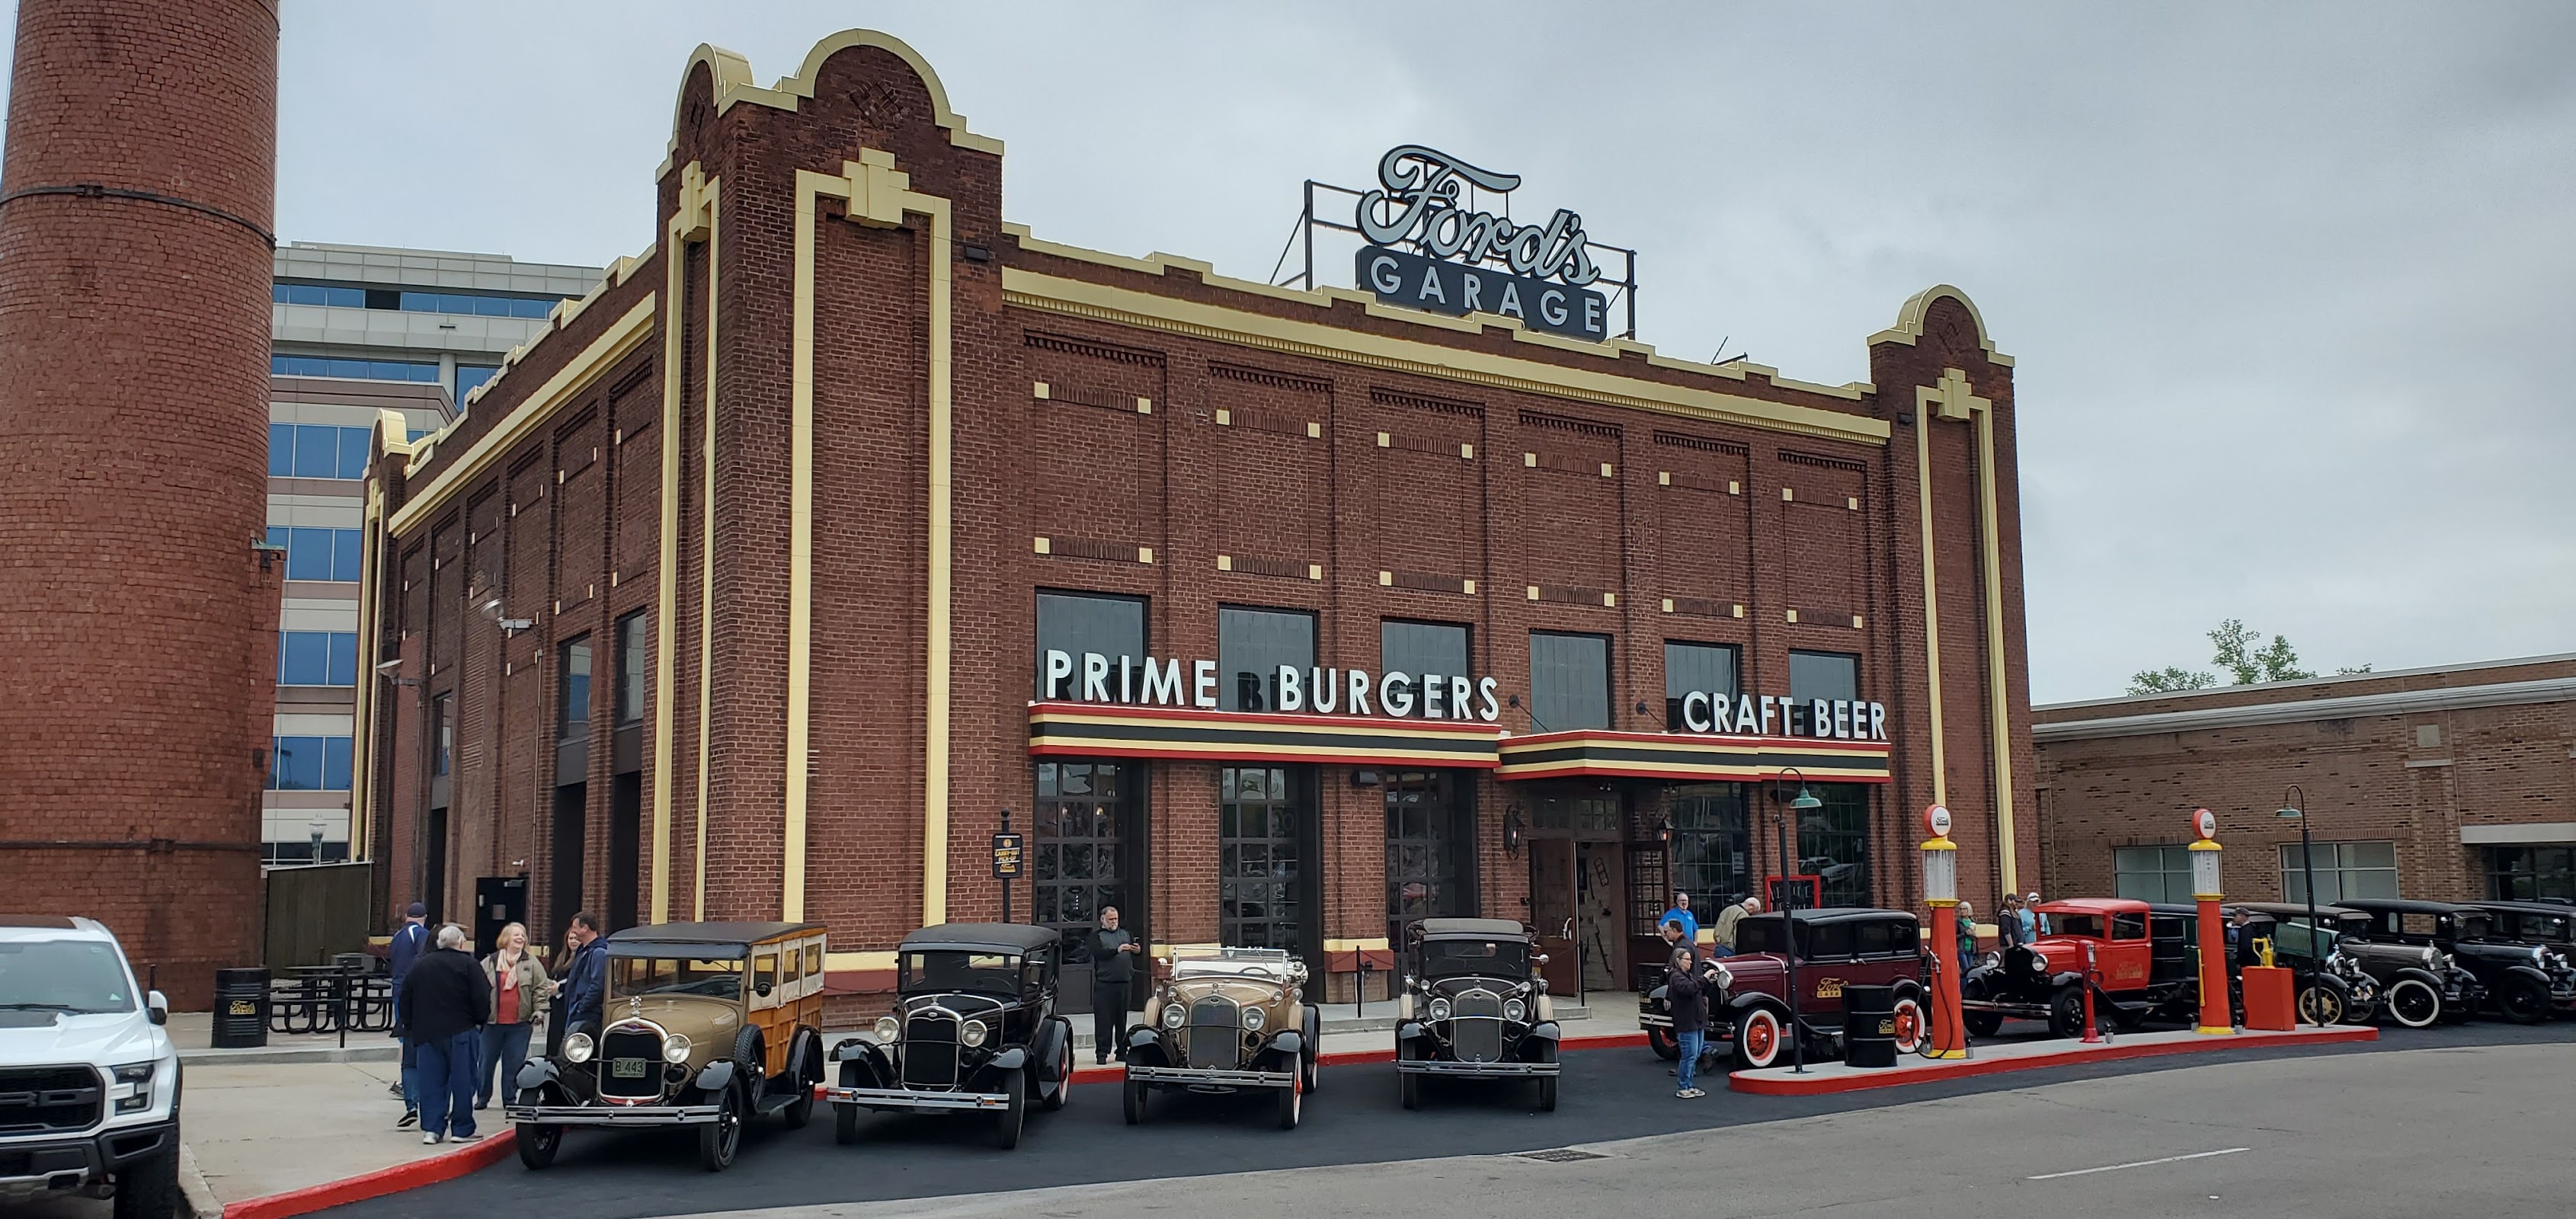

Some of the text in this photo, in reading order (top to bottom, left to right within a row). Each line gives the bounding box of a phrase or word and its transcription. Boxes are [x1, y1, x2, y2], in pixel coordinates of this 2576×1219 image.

[1356, 144, 1601, 286] Ford's
[1371, 255, 1601, 334] GARAGE
[1045, 648, 1499, 721] PRIME BURGERS
[1682, 690, 1887, 740] CRAFT BEER
[625, 1061, 643, 1072] 443
